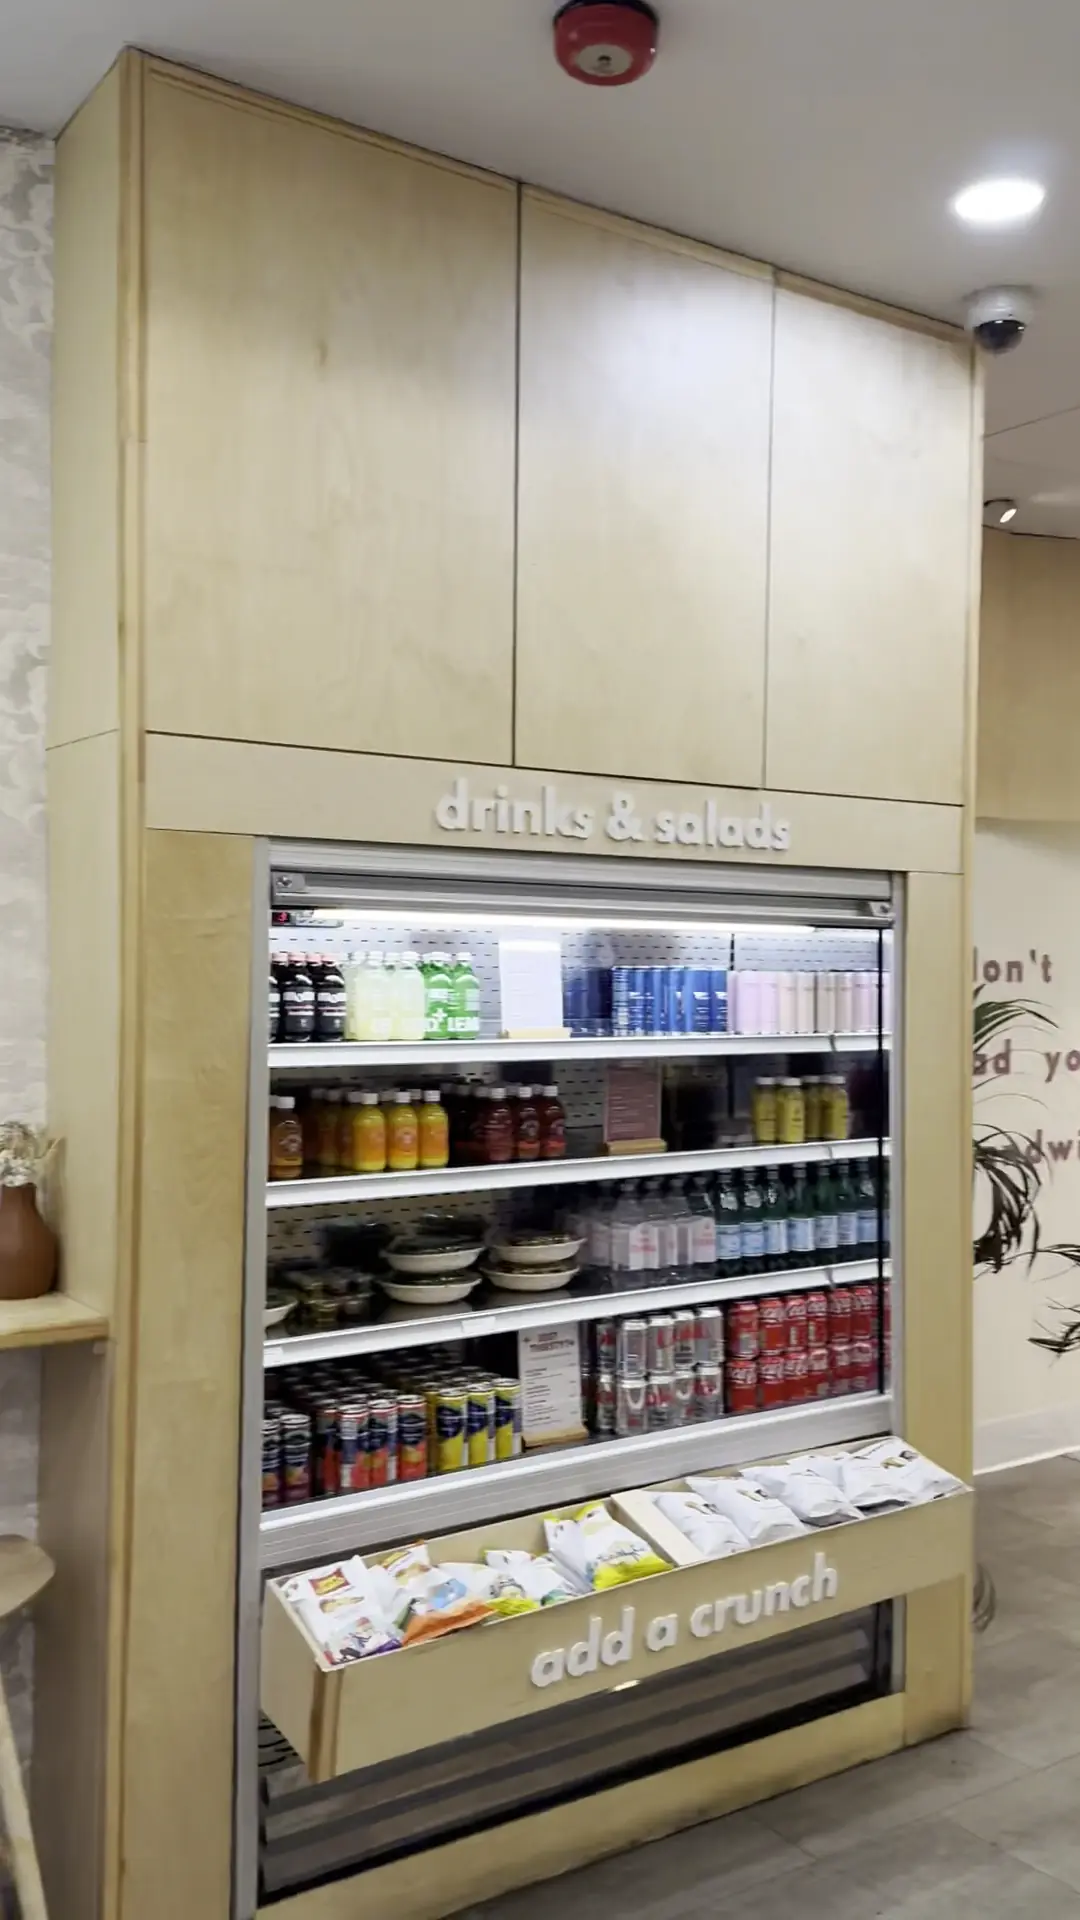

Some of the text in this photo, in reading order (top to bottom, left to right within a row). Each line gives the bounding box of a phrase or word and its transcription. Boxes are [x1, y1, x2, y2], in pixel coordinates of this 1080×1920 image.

[435, 777, 792, 850] drinks & salads
[530, 1552, 838, 1688] add a crunch
